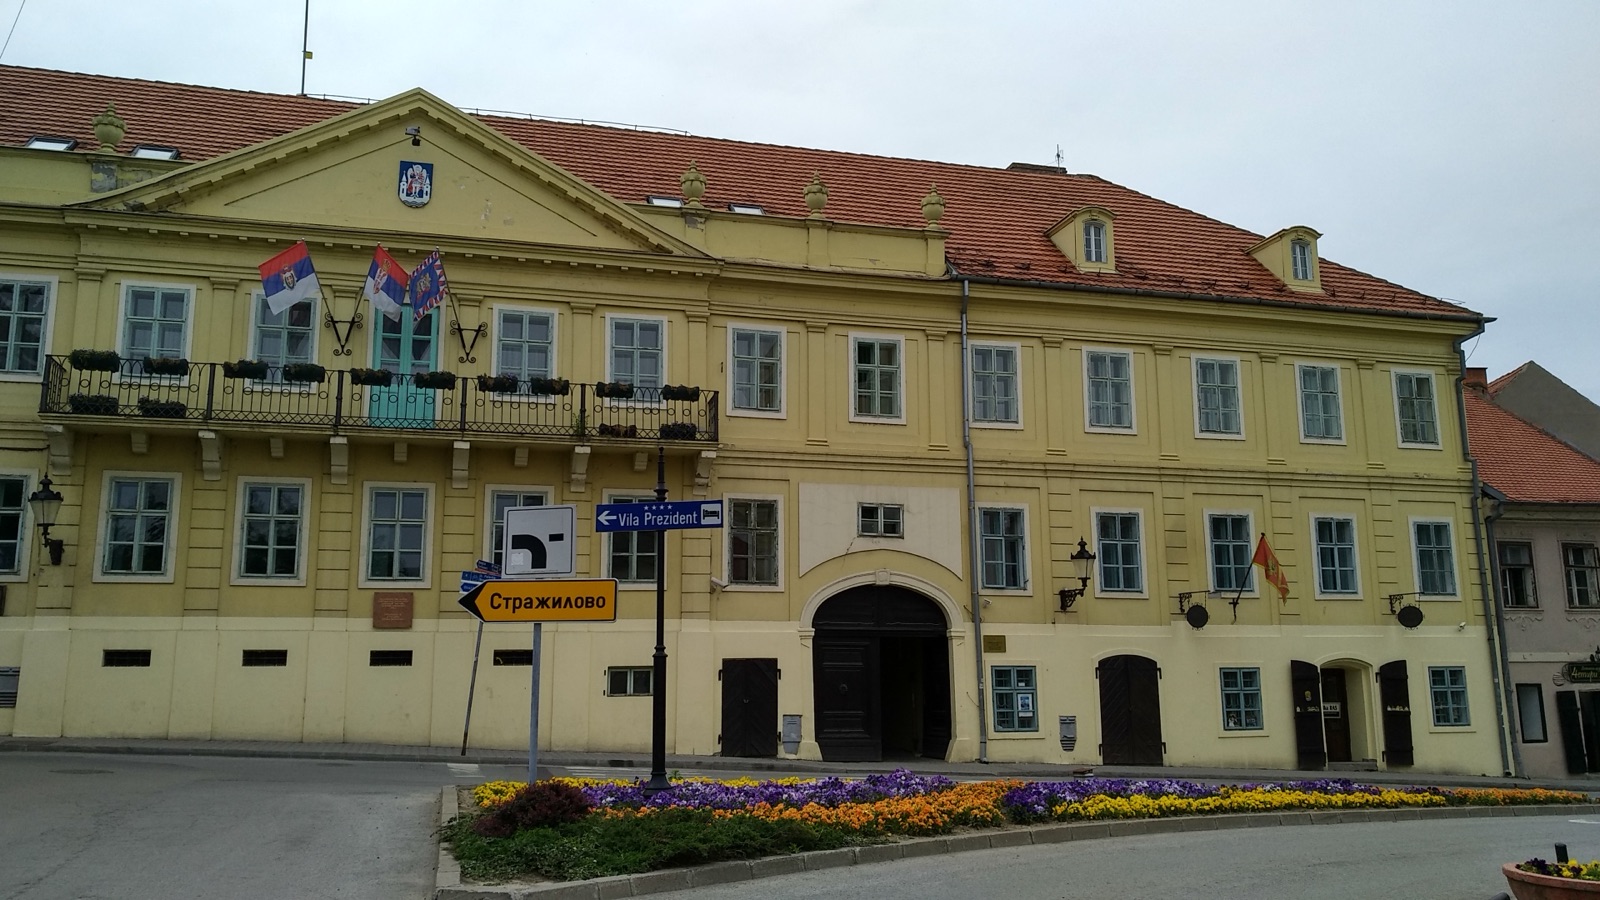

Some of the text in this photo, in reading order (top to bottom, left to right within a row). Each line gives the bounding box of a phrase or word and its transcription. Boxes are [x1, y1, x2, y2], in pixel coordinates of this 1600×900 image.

[618, 511, 698, 527] Vila Prezident
[490, 592, 606, 614] Стражилово
